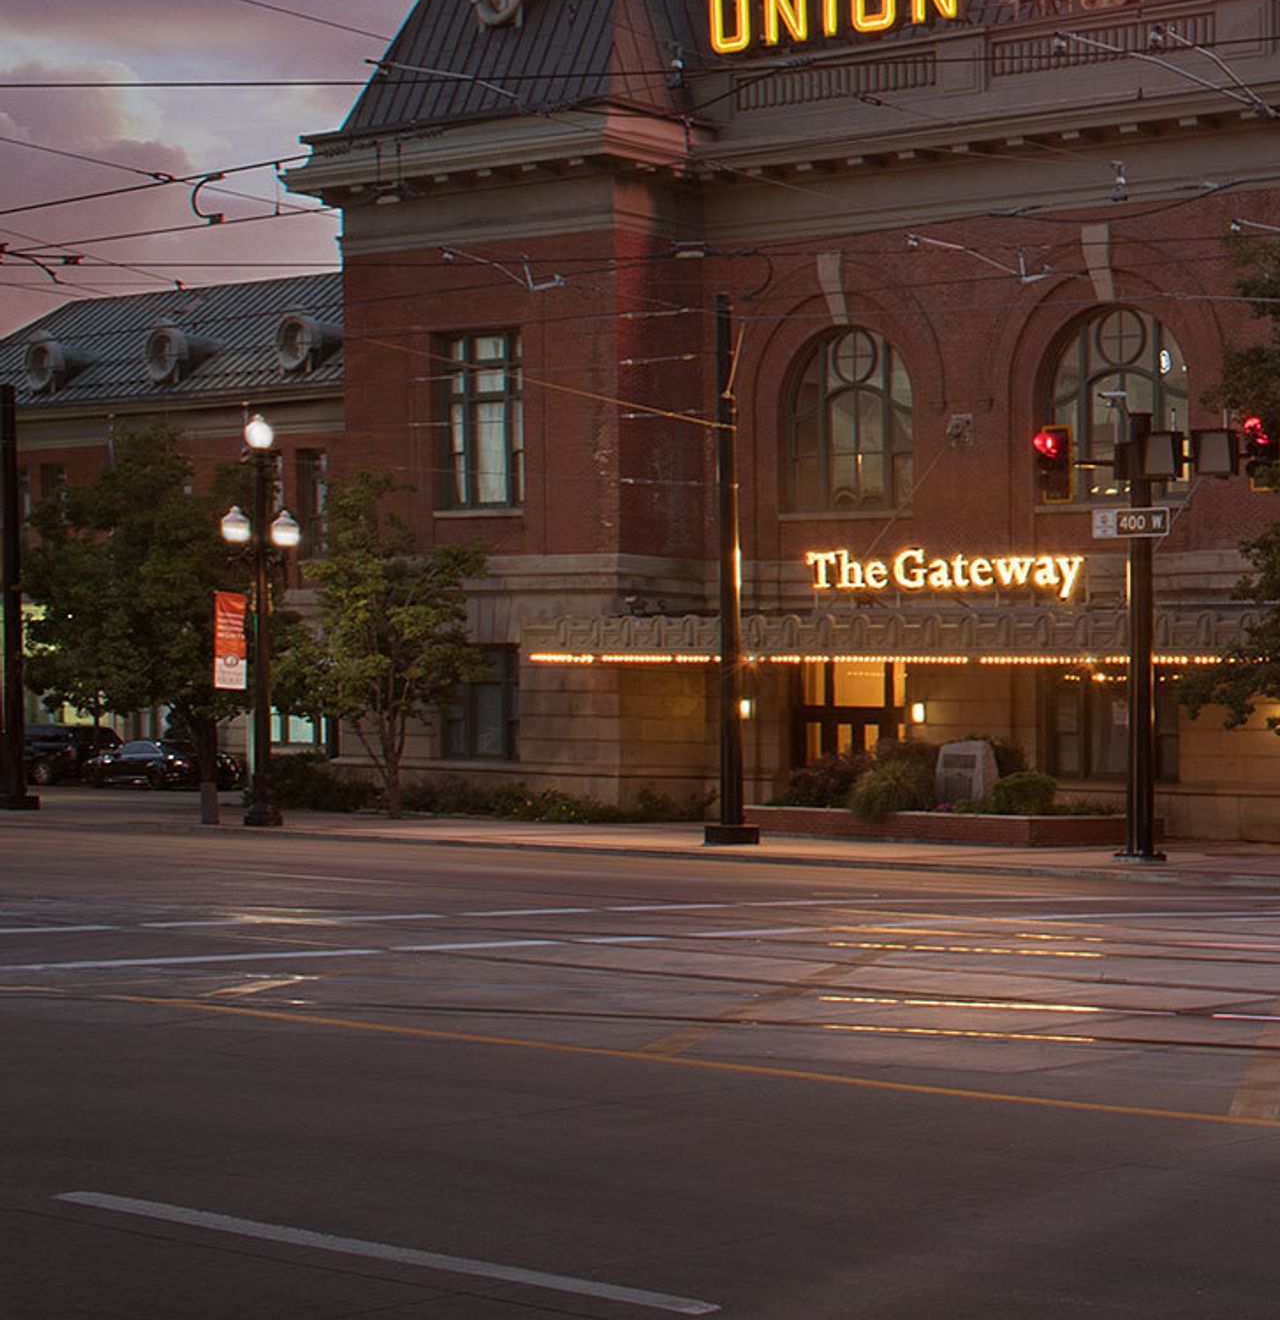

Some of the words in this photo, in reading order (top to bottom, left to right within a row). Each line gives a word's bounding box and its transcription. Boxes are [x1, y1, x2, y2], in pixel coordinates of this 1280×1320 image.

[1119, 515, 1146, 530] 400
[806, 549, 888, 589] The
[894, 547, 1084, 599] Gateway
